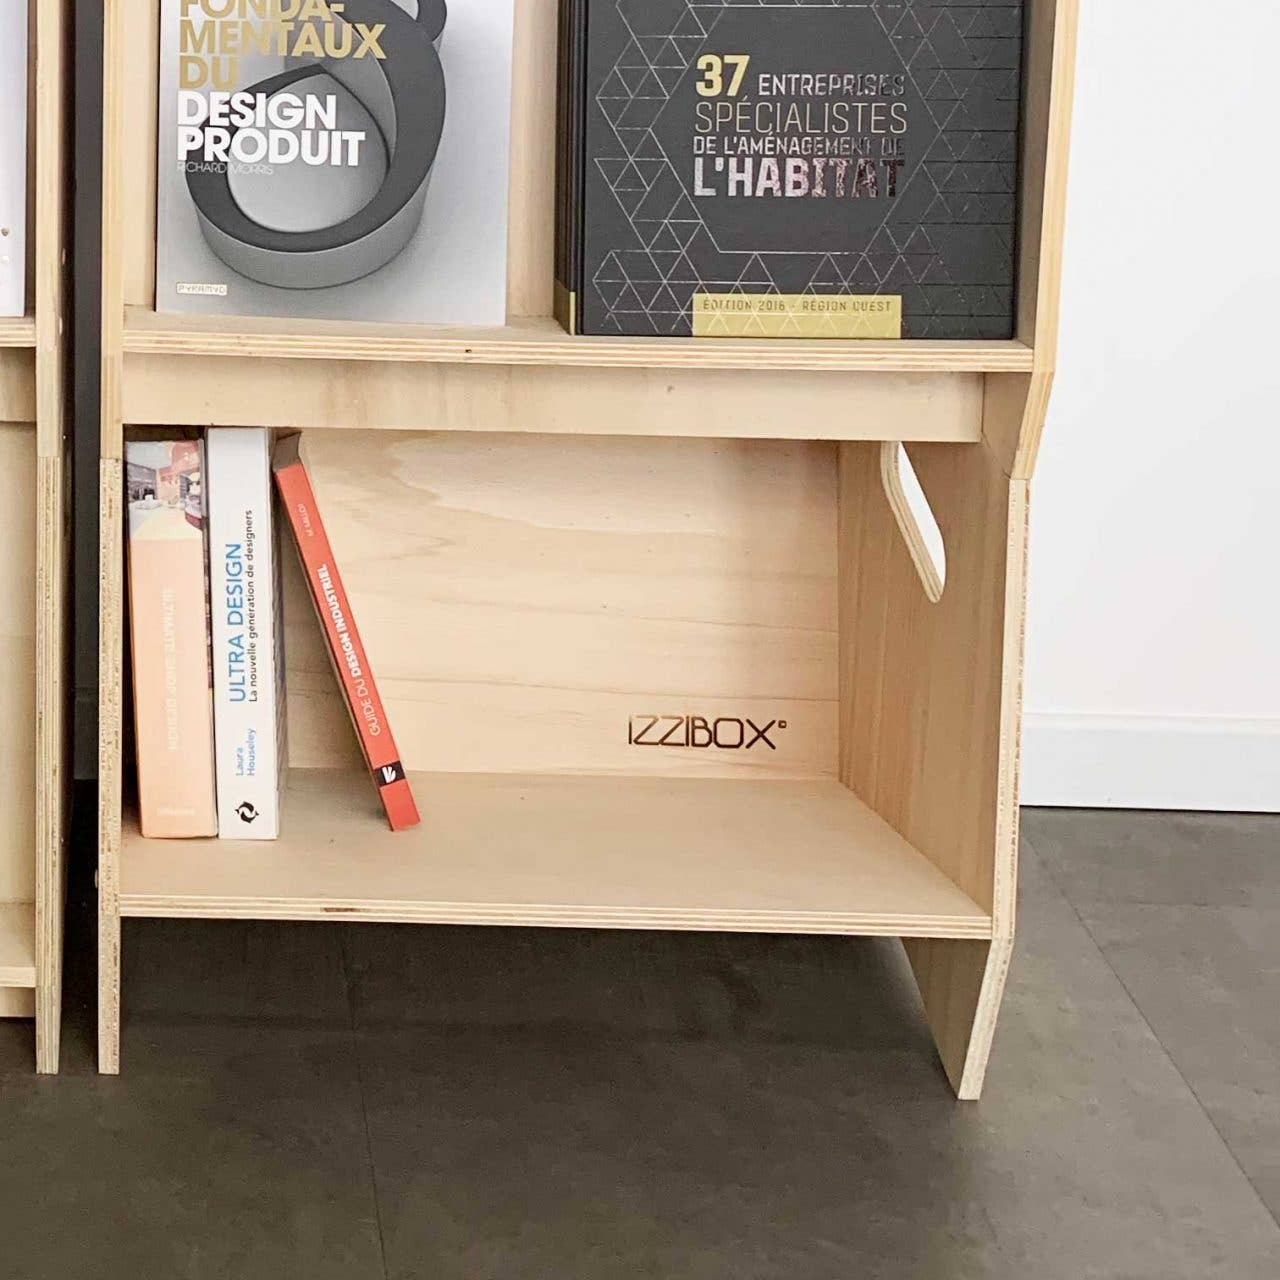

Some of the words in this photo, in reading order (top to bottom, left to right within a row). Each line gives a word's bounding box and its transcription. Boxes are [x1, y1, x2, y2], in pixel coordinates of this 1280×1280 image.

[179, 20, 388, 60] MENTAUX
[179, 56, 238, 91] DU
[695, 54, 751, 98] 37
[758, 73, 906, 97] ENTREPRISES
[177, 92, 337, 130] DESIGN
[695, 95, 908, 134] SPÉCIALISTES
[176, 125, 366, 167] PRODUIT
[694, 137, 717, 155] DE
[881, 137, 905, 156] DE
[694, 157, 906, 198] L'HABITAT
[703, 296, 752, 311] ÉDITION
[802, 296, 847, 312] RÉGION
[853, 300, 891, 312] OUEST
[244, 510, 256, 561] designers
[225, 543, 244, 626] DESIGN
[245, 564, 255, 577] de
[246, 581, 259, 639] génération
[317, 563, 348, 633] INDUSTRIEL
[228, 633, 246, 702] ULTRA
[246, 642, 258, 686] nouvelle
[338, 631, 362, 678] DESIGN
[249, 690, 258, 702] La
[354, 677, 371, 698] DU
[359, 697, 381, 737] GUIDE
[236, 747, 244, 776] Laura
